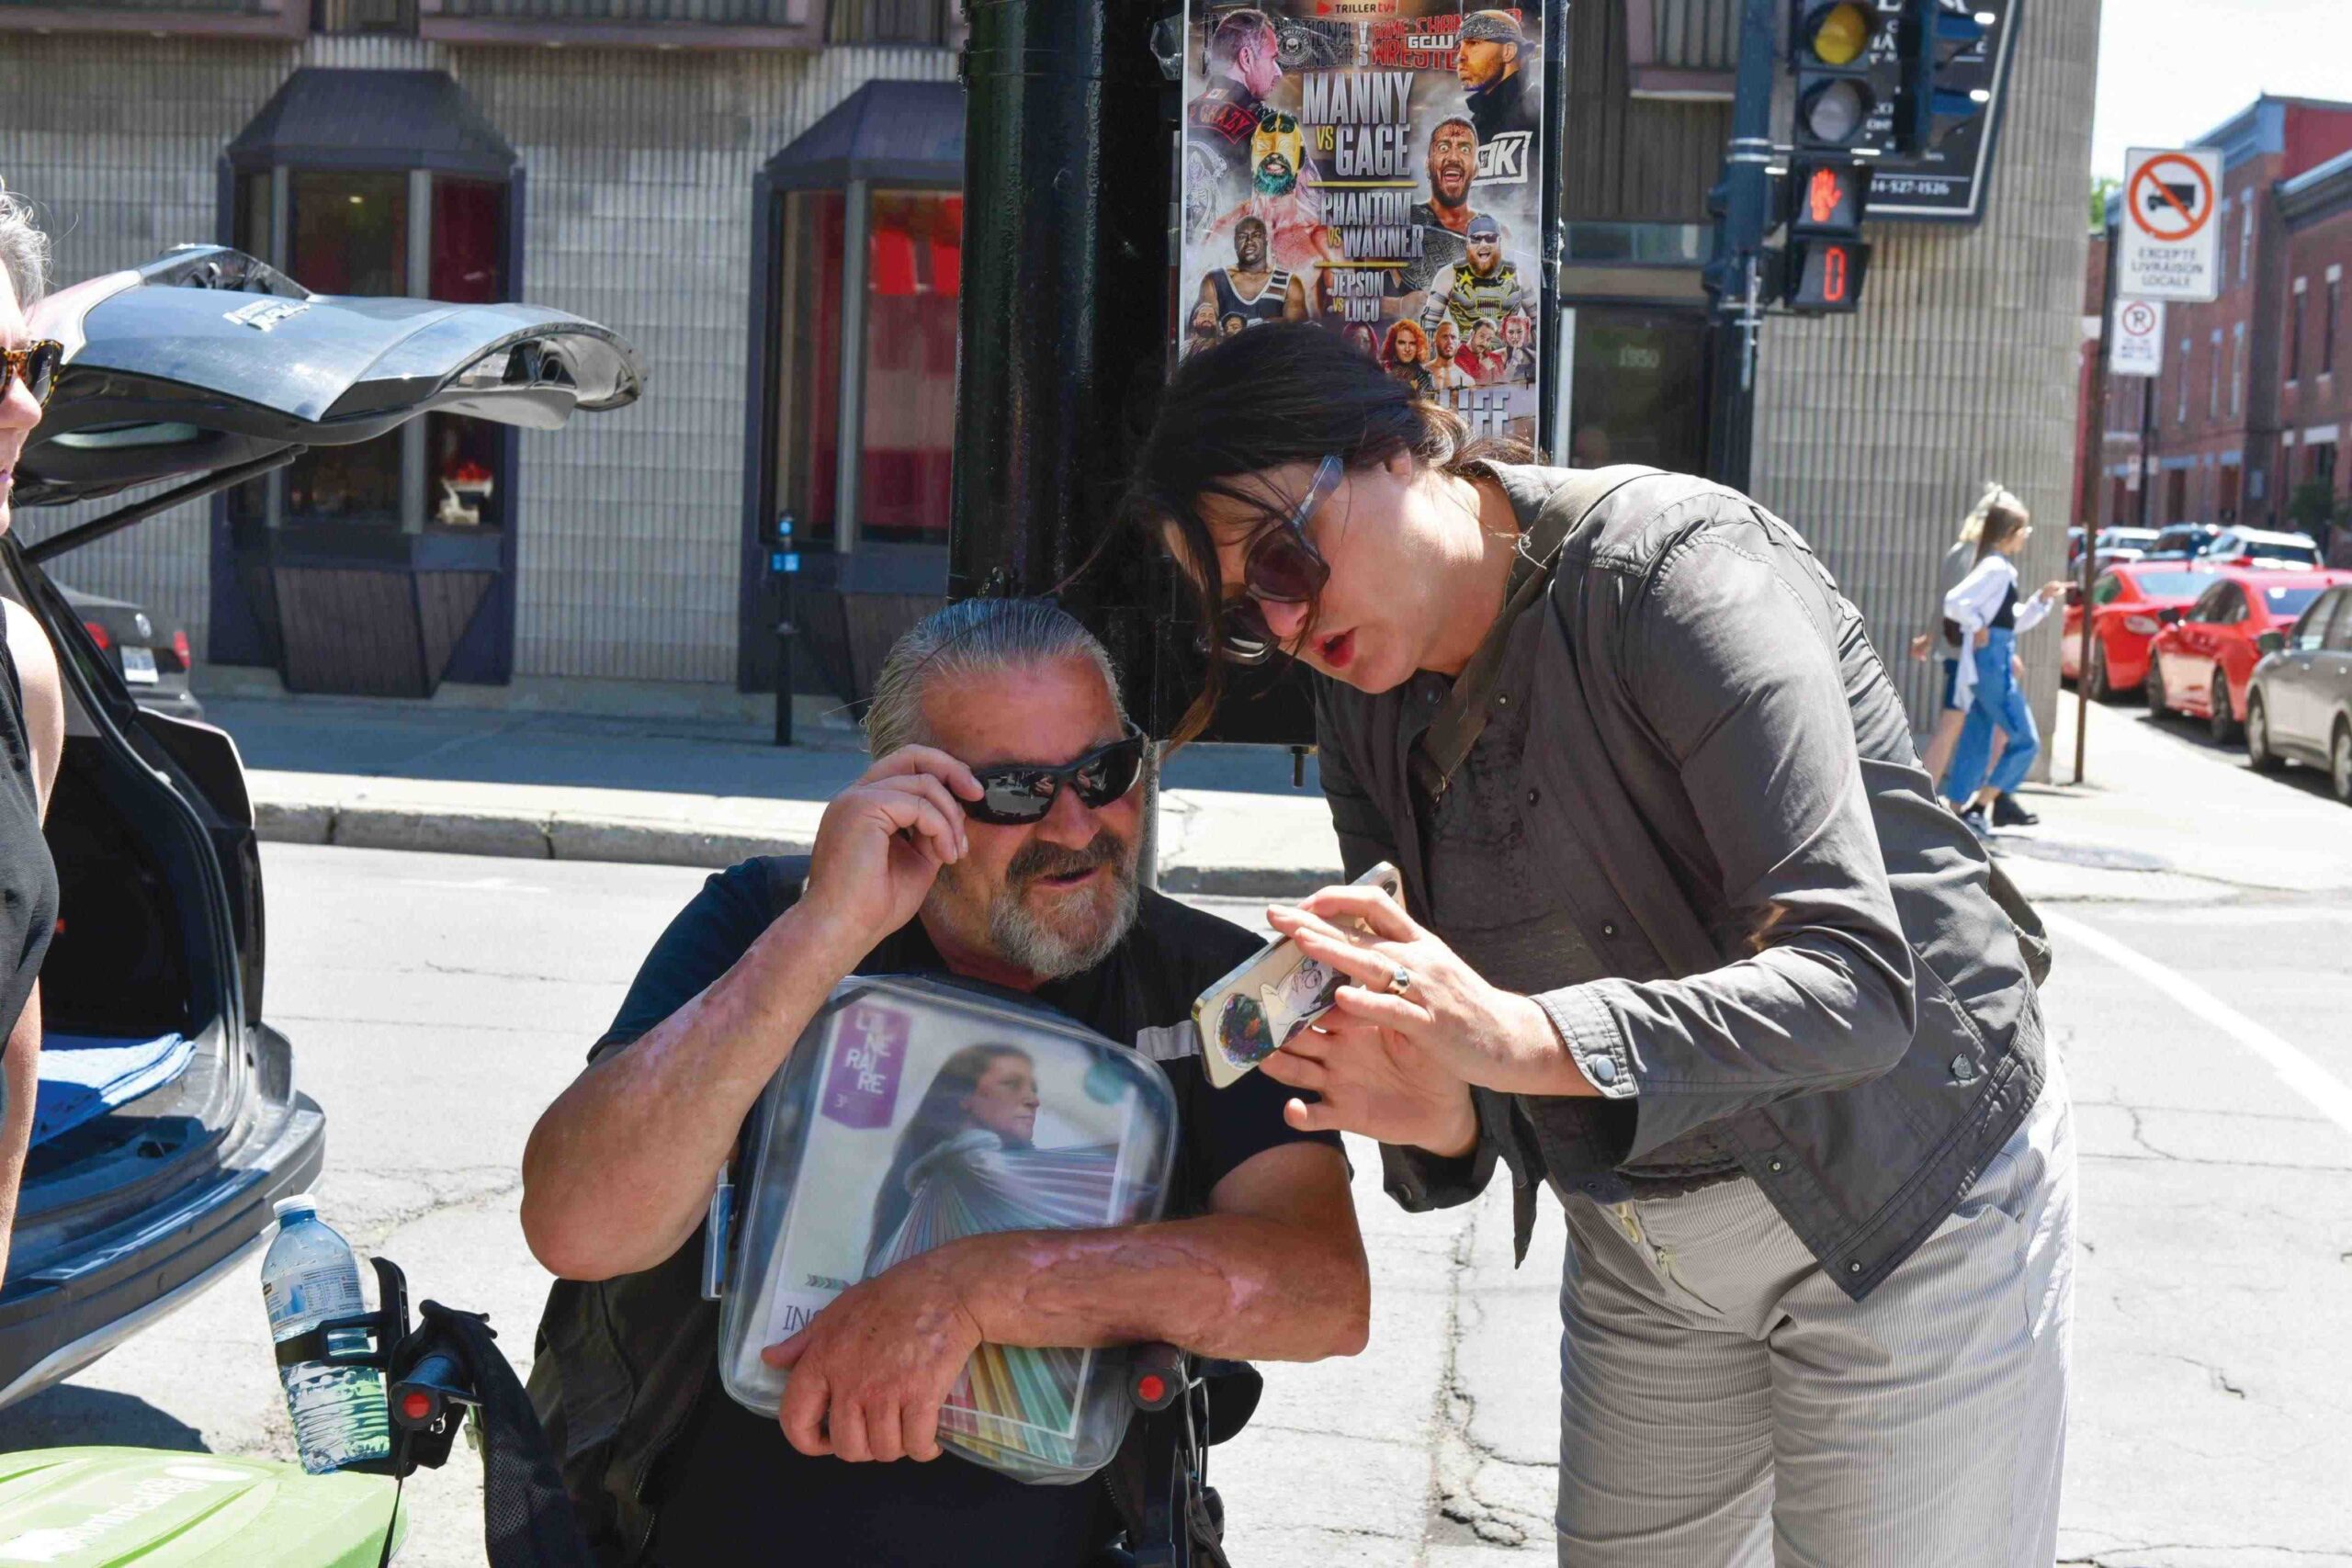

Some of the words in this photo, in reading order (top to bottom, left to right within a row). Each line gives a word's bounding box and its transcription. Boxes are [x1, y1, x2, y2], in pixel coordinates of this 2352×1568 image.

[1336, 4, 1376, 14] TRILLER
[1408, 35, 1453, 50] GCW
[1302, 72, 1413, 124] MANNY
[1316, 125, 1334, 151] VS
[1335, 123, 1411, 176] GAGE
[1320, 192, 1411, 226] PHANTOM
[1328, 227, 1341, 247] VS
[1342, 224, 1424, 257] WARNER
[2132, 260, 2203, 274] LIVRAISON
[1331, 271, 1385, 297] JEPSON
[2142, 276, 2190, 287] LOCALE
[1332, 298, 1344, 312] VS
[856, 1070, 888, 1095] RE
